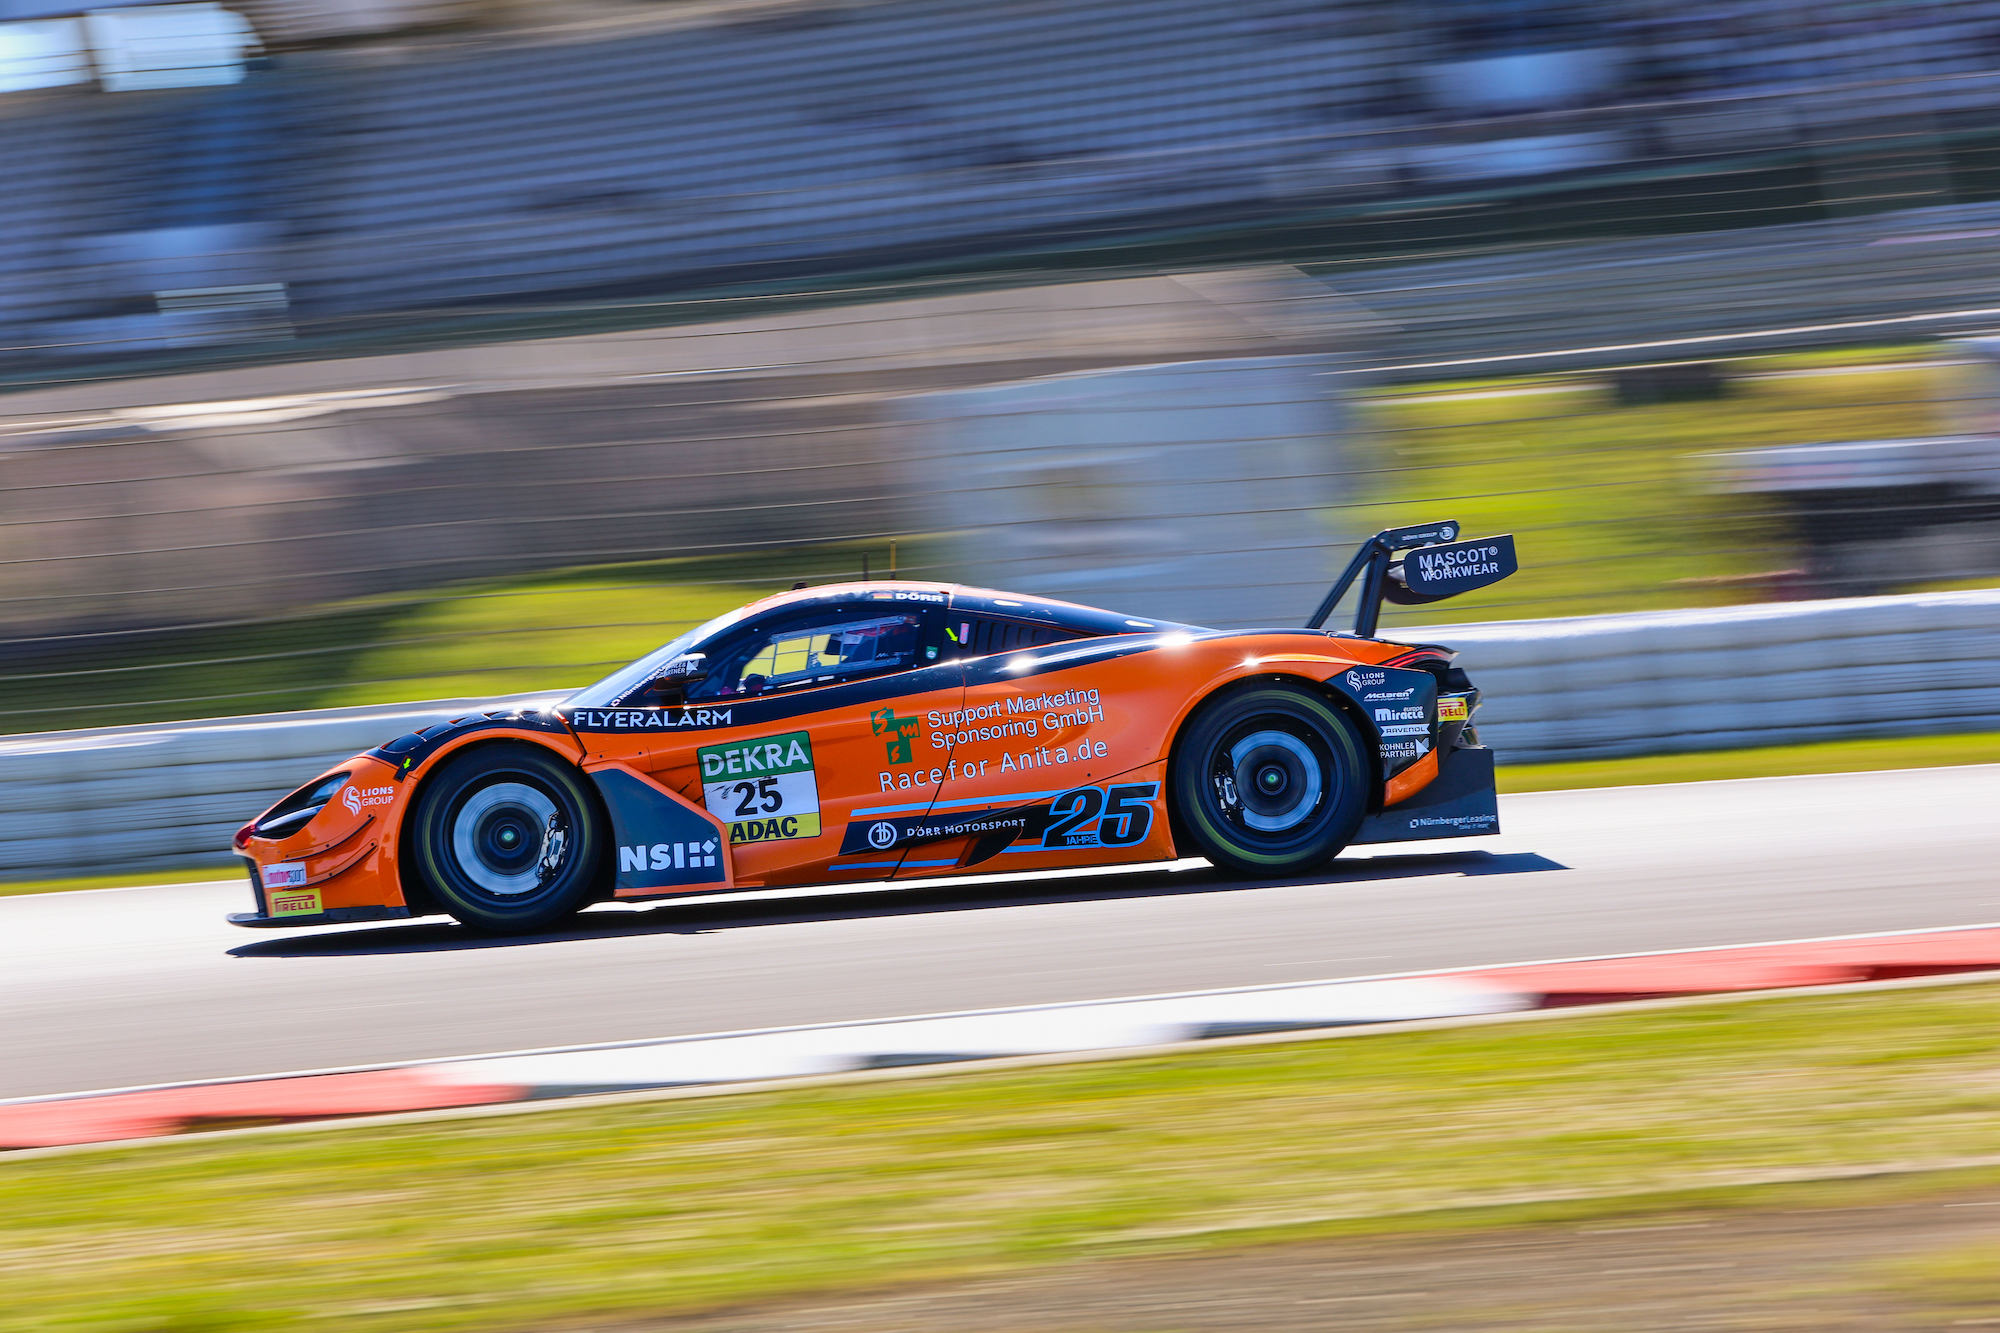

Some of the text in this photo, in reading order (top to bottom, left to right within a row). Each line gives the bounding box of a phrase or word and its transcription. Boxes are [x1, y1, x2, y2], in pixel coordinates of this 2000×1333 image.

[1420, 562, 1500, 582] WORKWEAR
[895, 592, 944, 603] DÖRR
[573, 709, 732, 728] FLYERALARM
[927, 688, 1099, 729] Support Marketing
[930, 704, 1104, 750] Sponsoring GmbH
[702, 739, 810, 777] DEKRA
[1000, 738, 1109, 774] Anita.de
[1380, 750, 1416, 758] PARTNER
[361, 786, 394, 797] LIONS
[361, 795, 395, 807] GROUP
[732, 777, 784, 817] 25
[1041, 780, 1162, 849] 25
[729, 816, 799, 842] ADAC
[906, 817, 1027, 838] DÖRR MOTORSPORT
